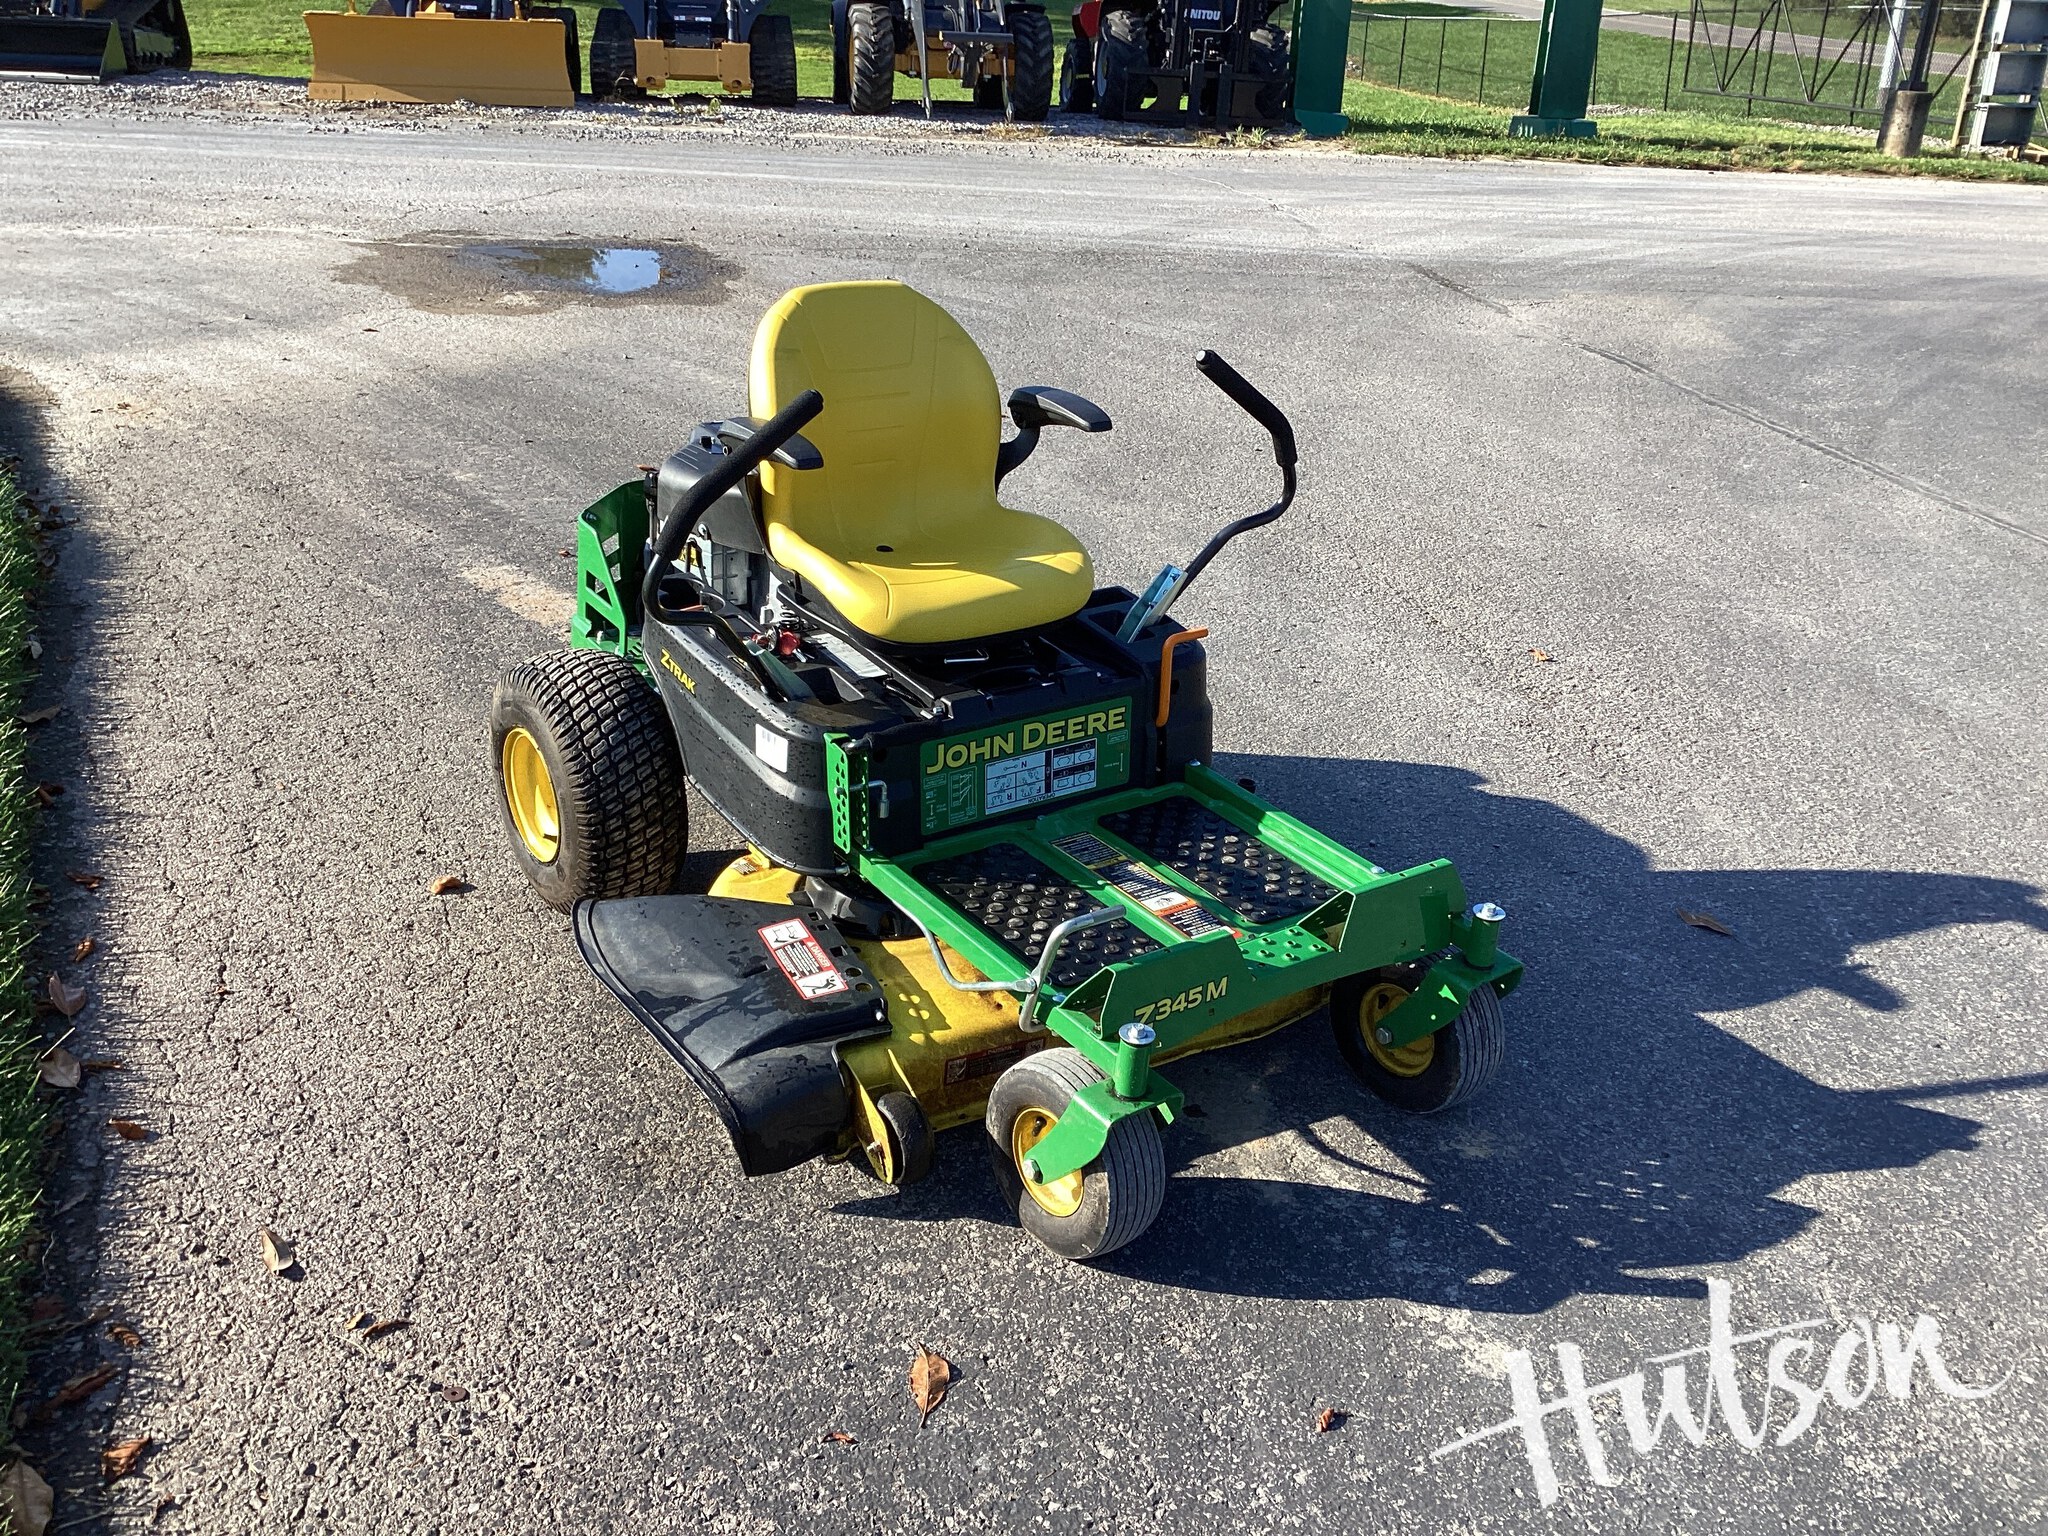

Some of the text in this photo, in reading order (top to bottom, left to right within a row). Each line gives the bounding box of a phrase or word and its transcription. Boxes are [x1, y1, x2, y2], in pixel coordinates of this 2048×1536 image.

[660, 648, 697, 695] ZTRAK
[926, 732, 1014, 774] JOHN
[1023, 706, 1126, 751] DEERE
[811, 945, 831, 967] DANGER
